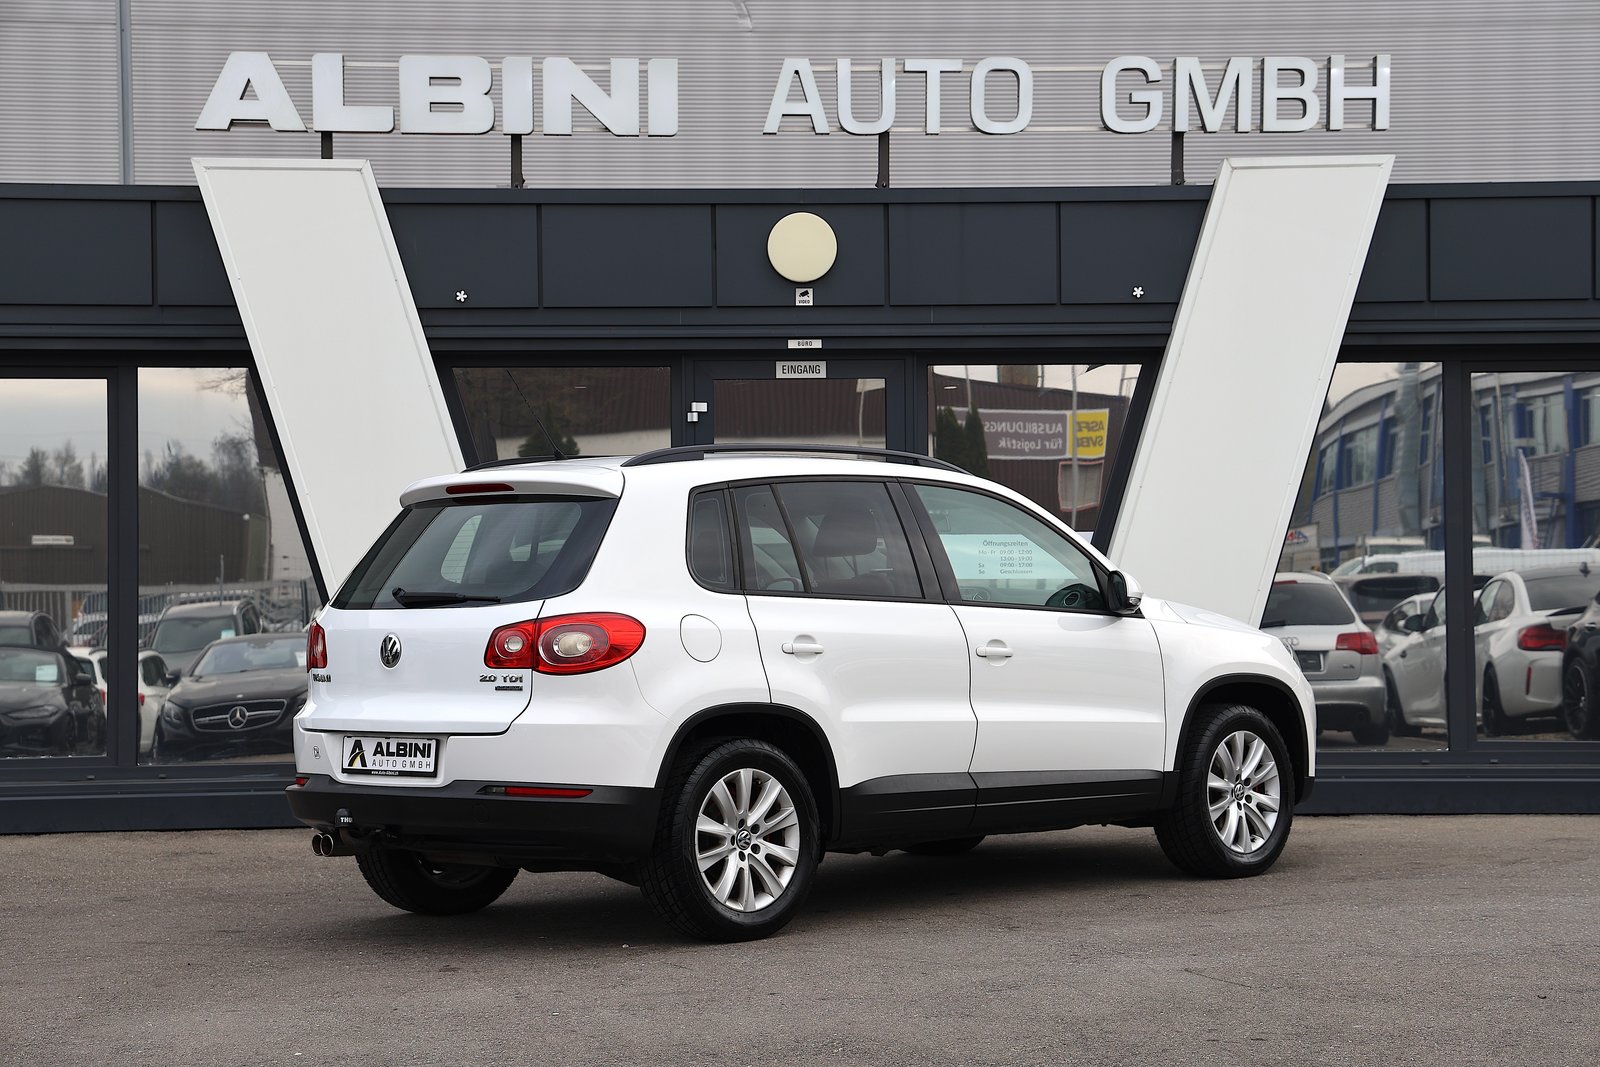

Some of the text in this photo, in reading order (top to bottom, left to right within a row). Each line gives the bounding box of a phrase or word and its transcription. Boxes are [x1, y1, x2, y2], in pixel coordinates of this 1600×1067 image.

[195, 51, 1391, 136] ALBINI AUTO GMBH
[781, 364, 821, 374] EINGANG
[373, 741, 432, 758] ALBINI
[372, 759, 431, 769] AUTO GMBH
